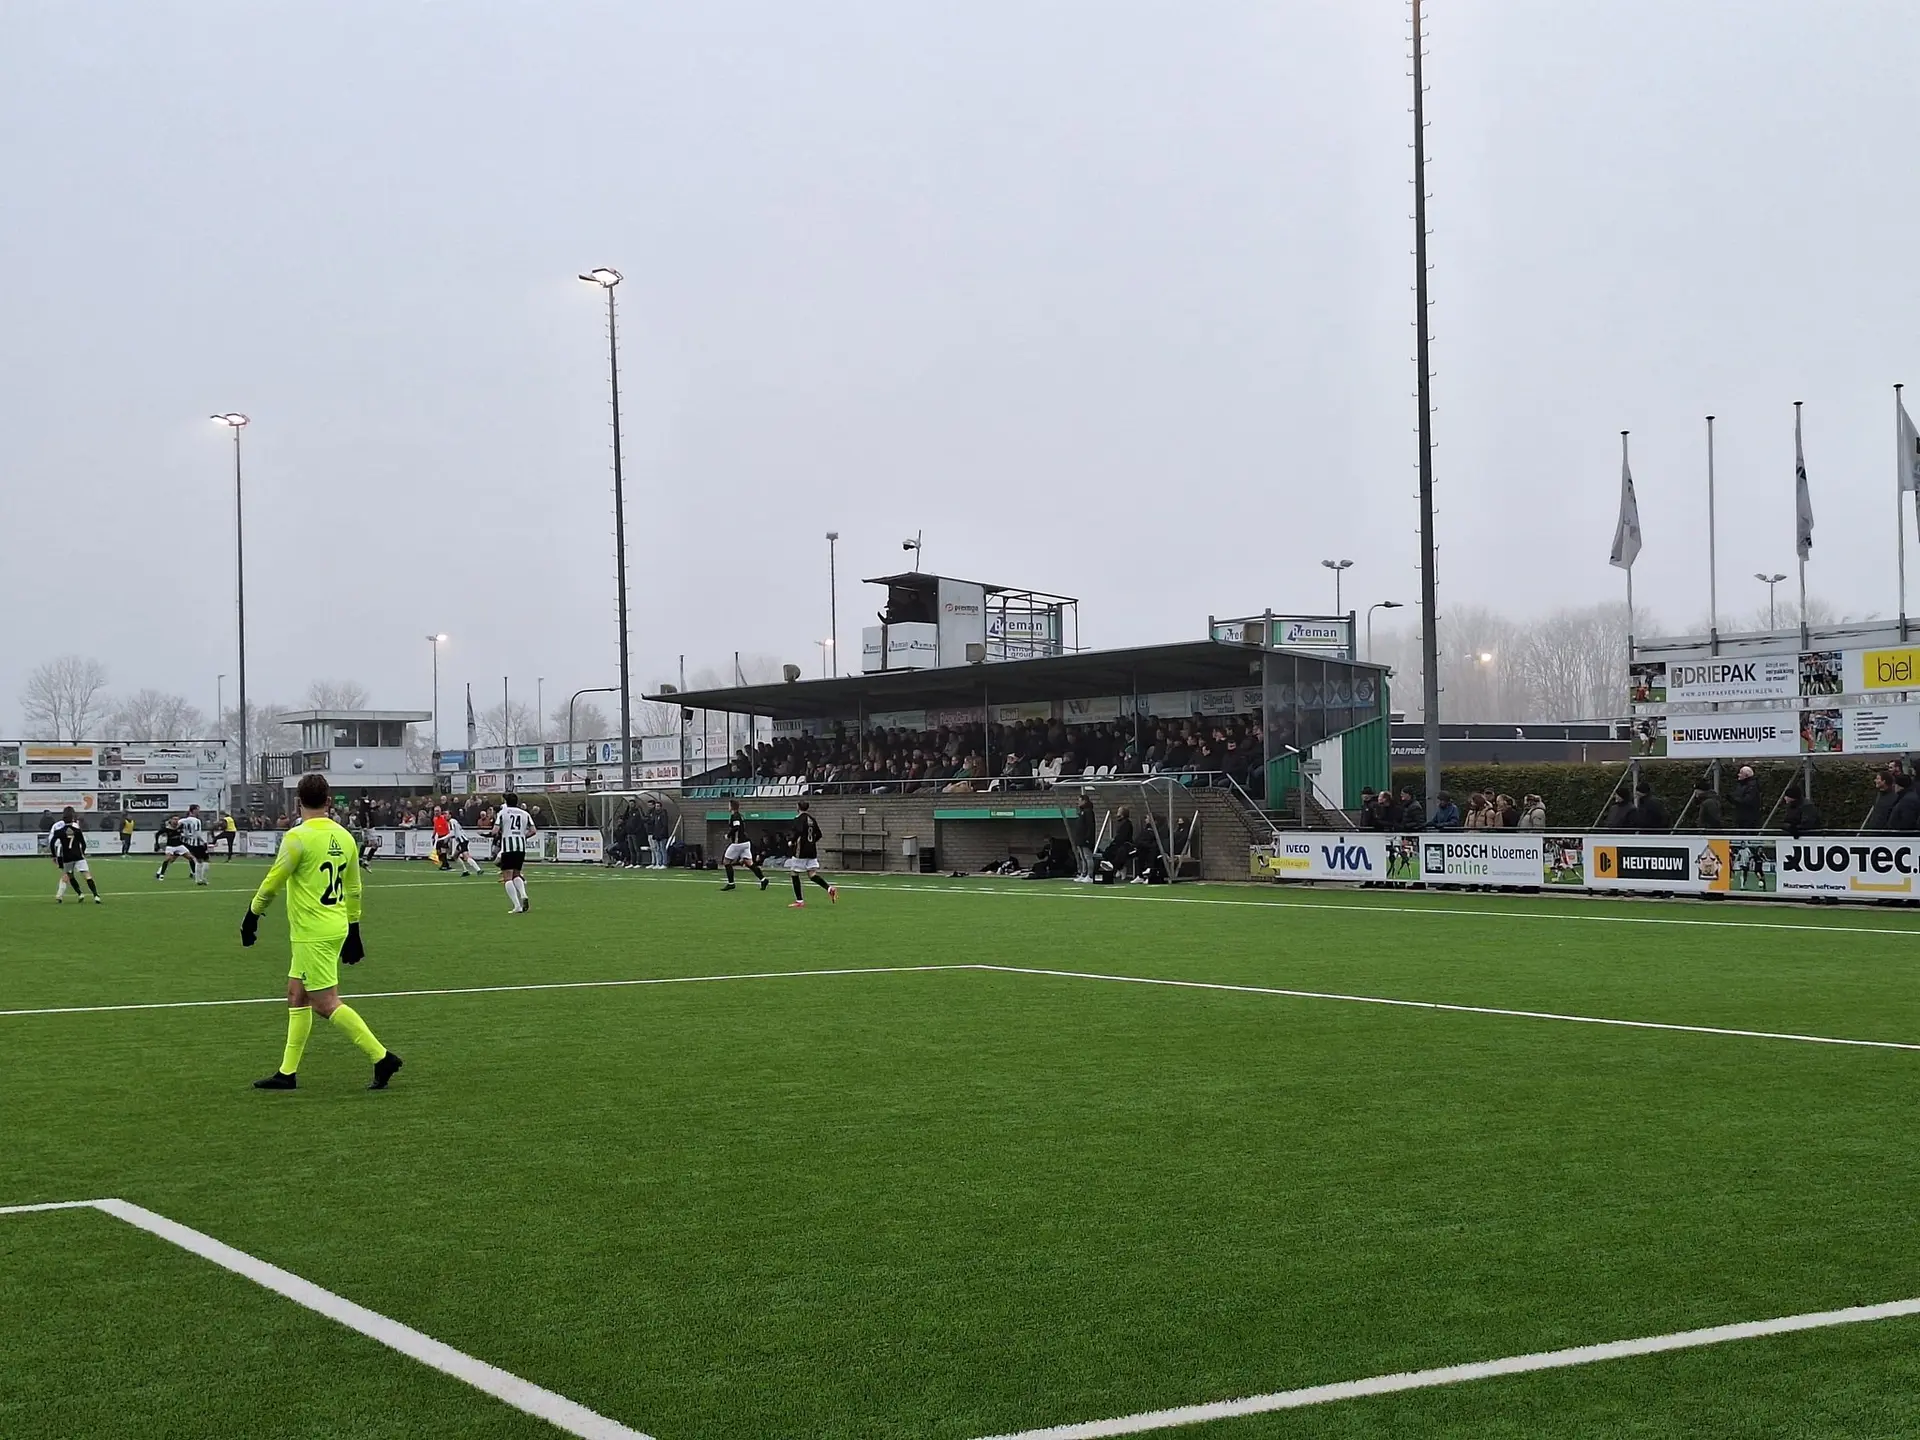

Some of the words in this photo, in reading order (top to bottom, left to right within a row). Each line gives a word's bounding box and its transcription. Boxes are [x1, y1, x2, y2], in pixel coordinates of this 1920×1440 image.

[1684, 663, 1757, 684] DRIEPAK
[1877, 655, 1912, 682] biel
[1685, 726, 1776, 742] NIEUWENHUIJSE
[510, 815, 521, 830] 24
[67, 836, 75, 848] 7
[807, 827, 814, 842] 8
[1286, 844, 1310, 853] IVECO
[1447, 844, 1488, 858] BOSCH
[1491, 846, 1538, 860] bloemen
[1447, 861, 1488, 875] online
[1623, 857, 1683, 870] HEUTBOUW
[320, 861, 347, 905] 26
